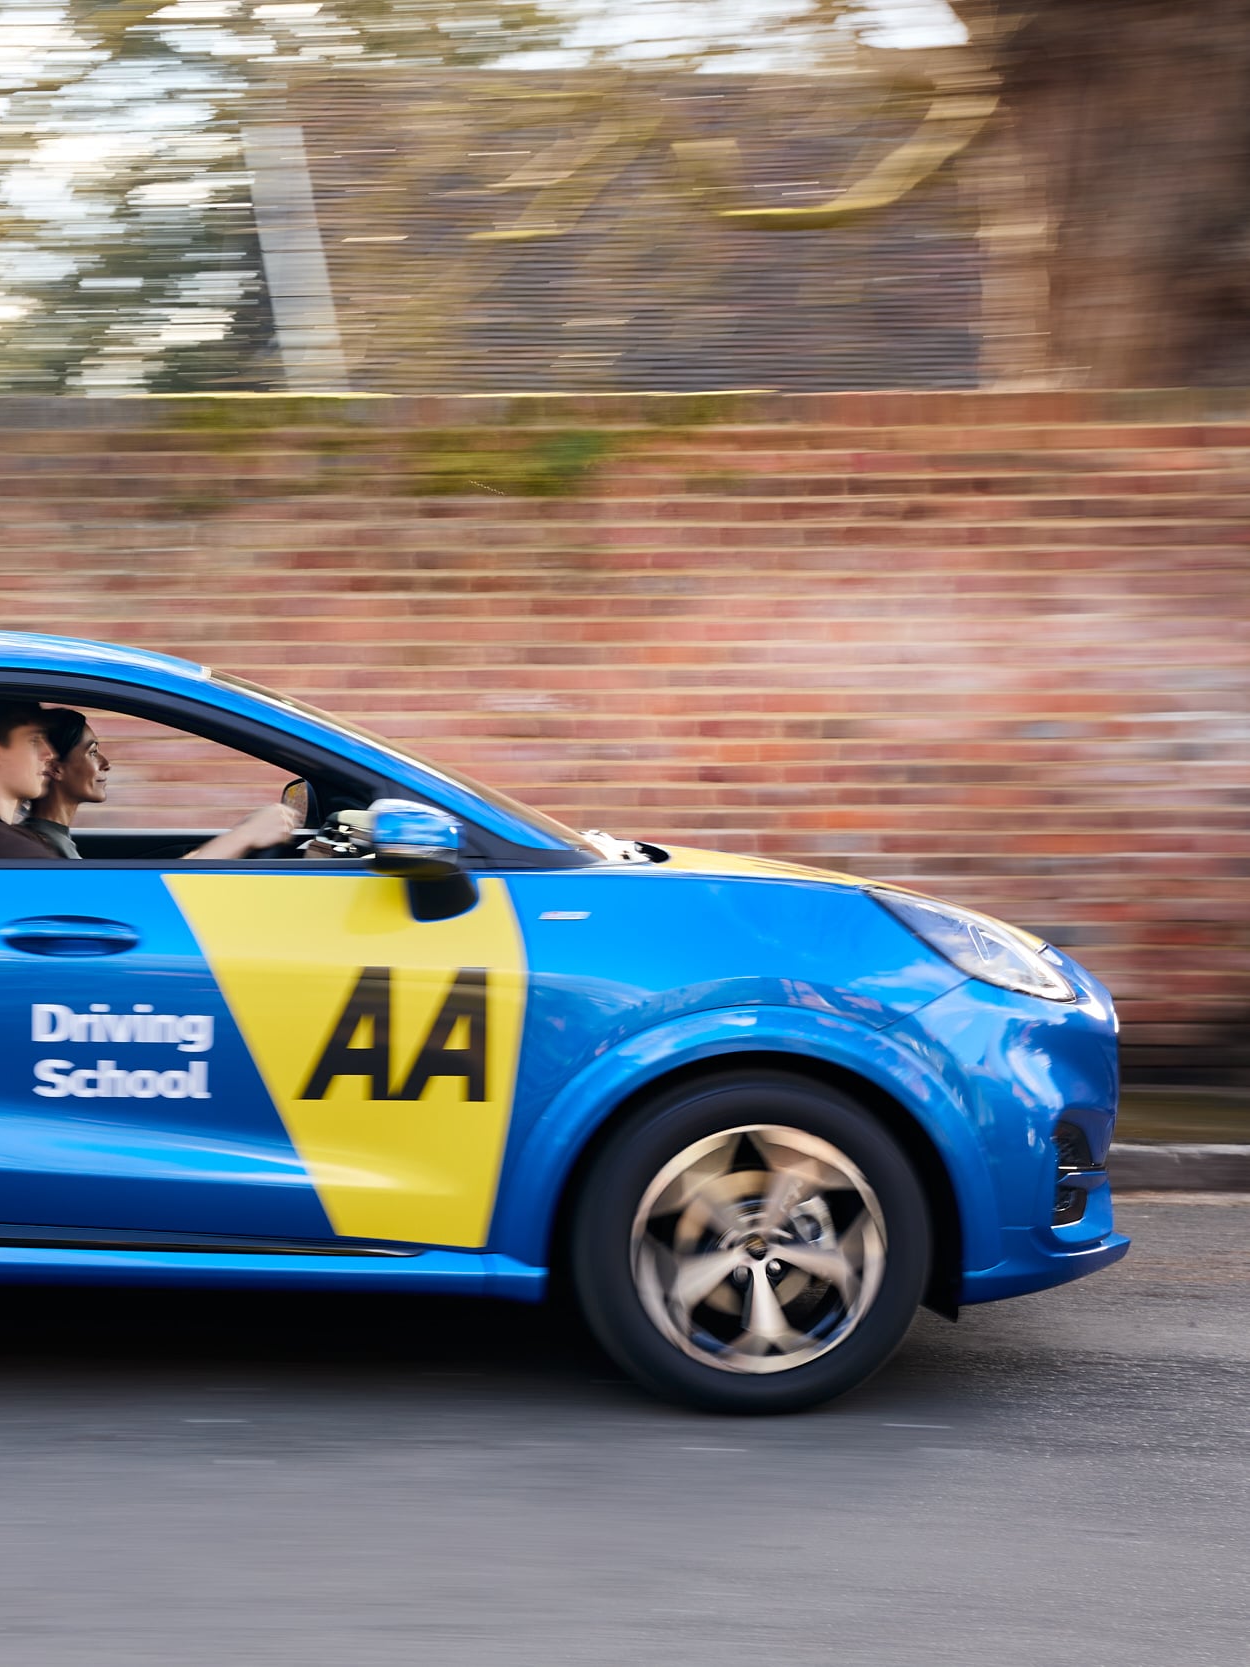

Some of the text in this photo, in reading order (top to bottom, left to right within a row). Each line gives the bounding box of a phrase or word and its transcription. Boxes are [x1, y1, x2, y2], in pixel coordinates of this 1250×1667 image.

[31, 1003, 215, 1053] Driving
[296, 966, 490, 1102] AA
[32, 1058, 212, 1099] School
